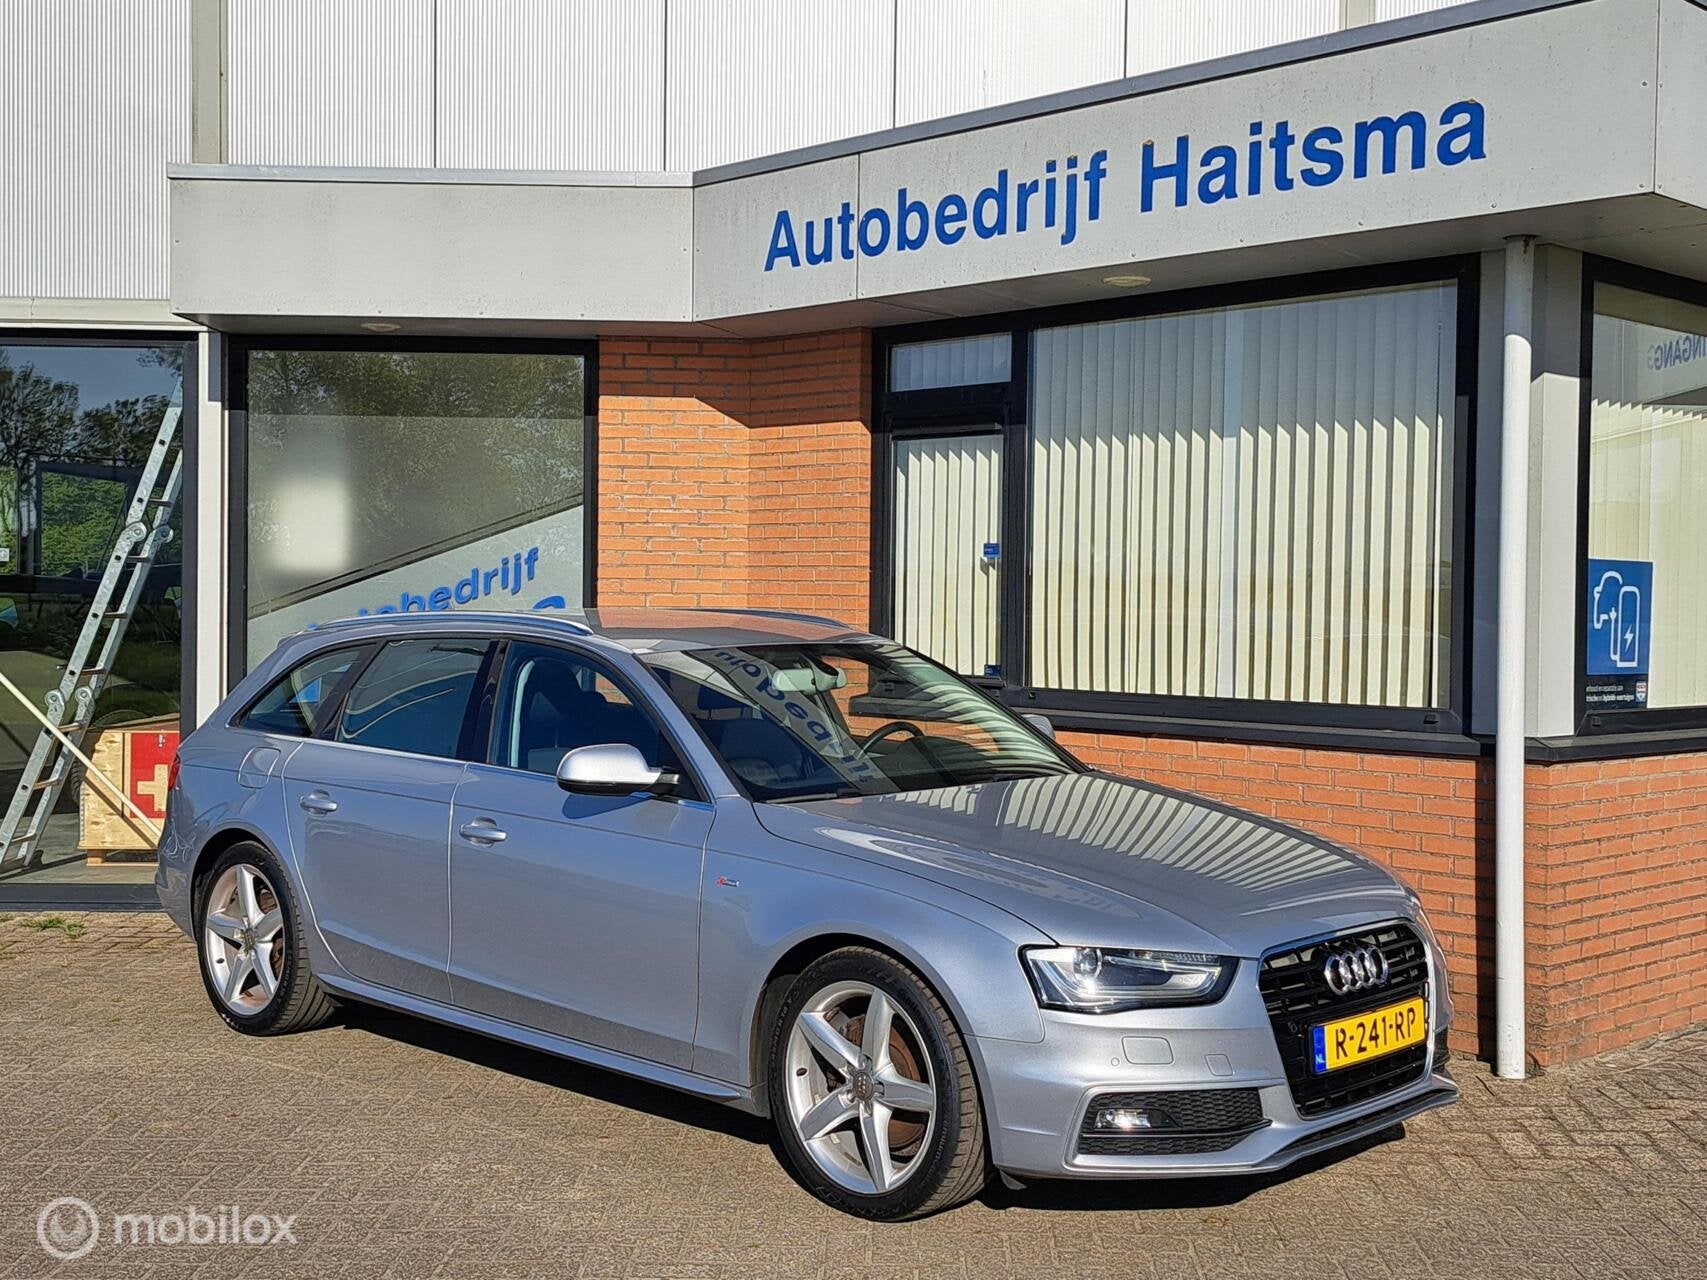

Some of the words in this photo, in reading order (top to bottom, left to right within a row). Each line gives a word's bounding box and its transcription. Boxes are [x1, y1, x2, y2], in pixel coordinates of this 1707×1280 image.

[763, 149, 1108, 272] Autobedrijf
[1139, 97, 1487, 213] Haitsma
[1335, 1006, 1416, 1060] R-241-RP
